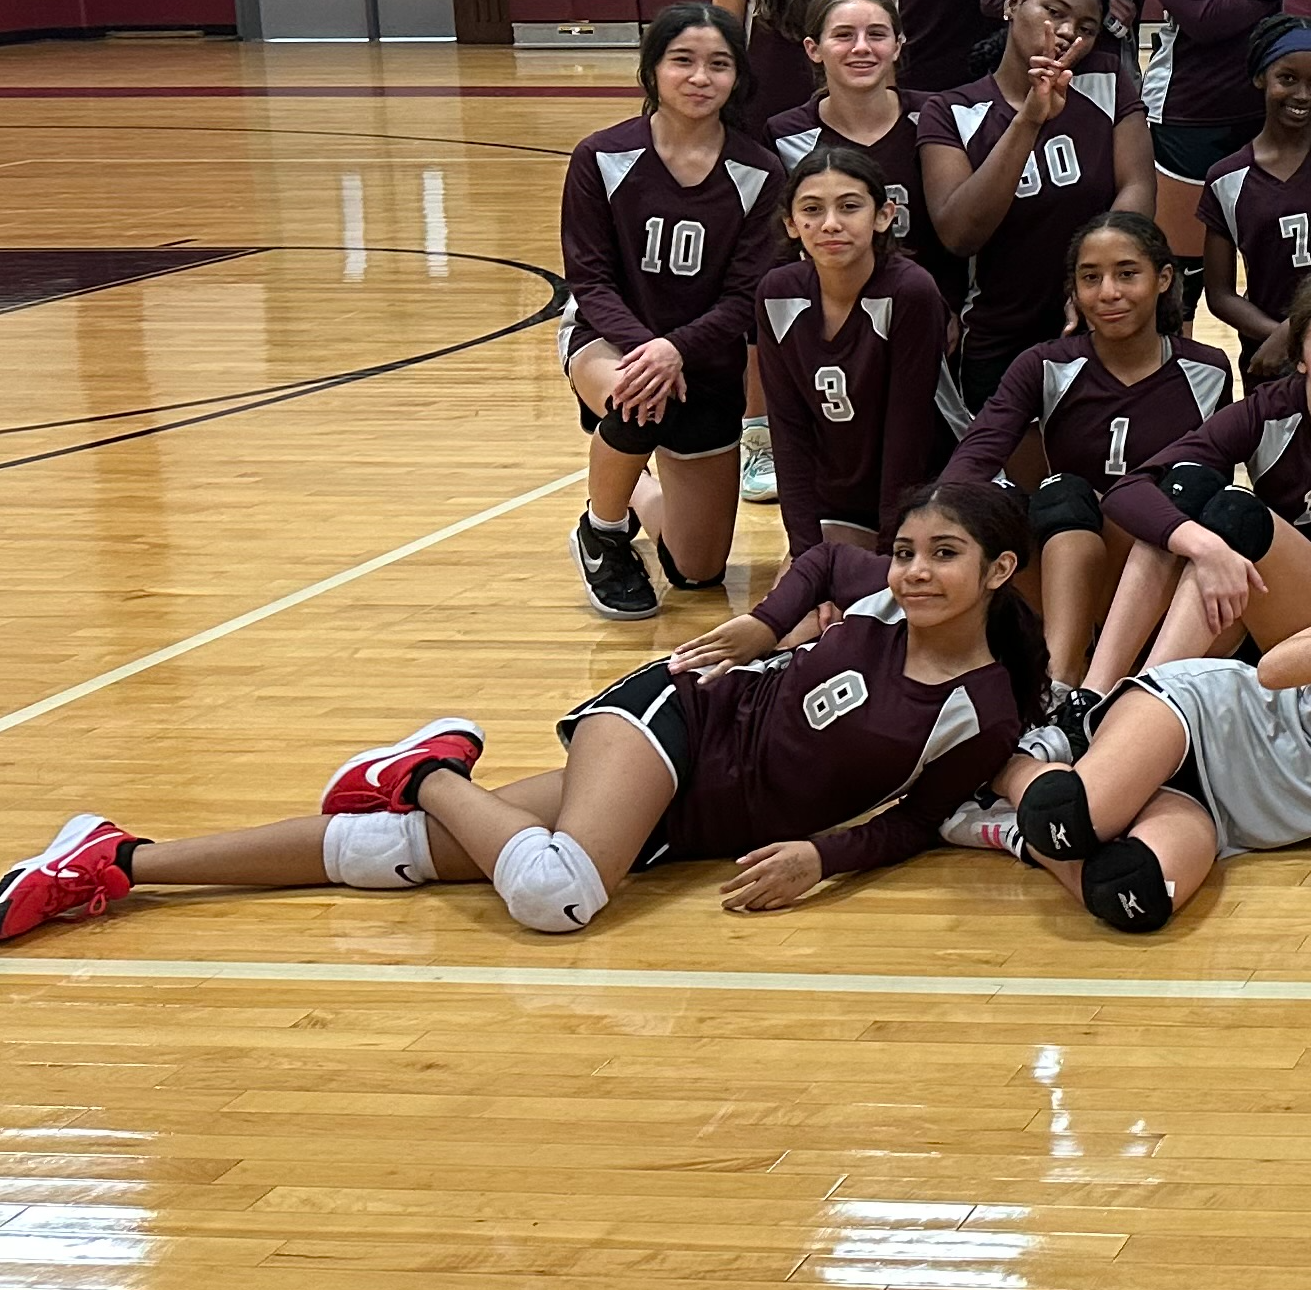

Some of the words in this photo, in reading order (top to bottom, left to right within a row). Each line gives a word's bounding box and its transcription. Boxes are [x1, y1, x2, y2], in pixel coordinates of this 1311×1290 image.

[641, 216, 706, 276] 10
[1279, 213, 1311, 268] 7
[815, 366, 855, 423] 3
[1105, 417, 1130, 476] 1
[803, 670, 869, 731] 8
